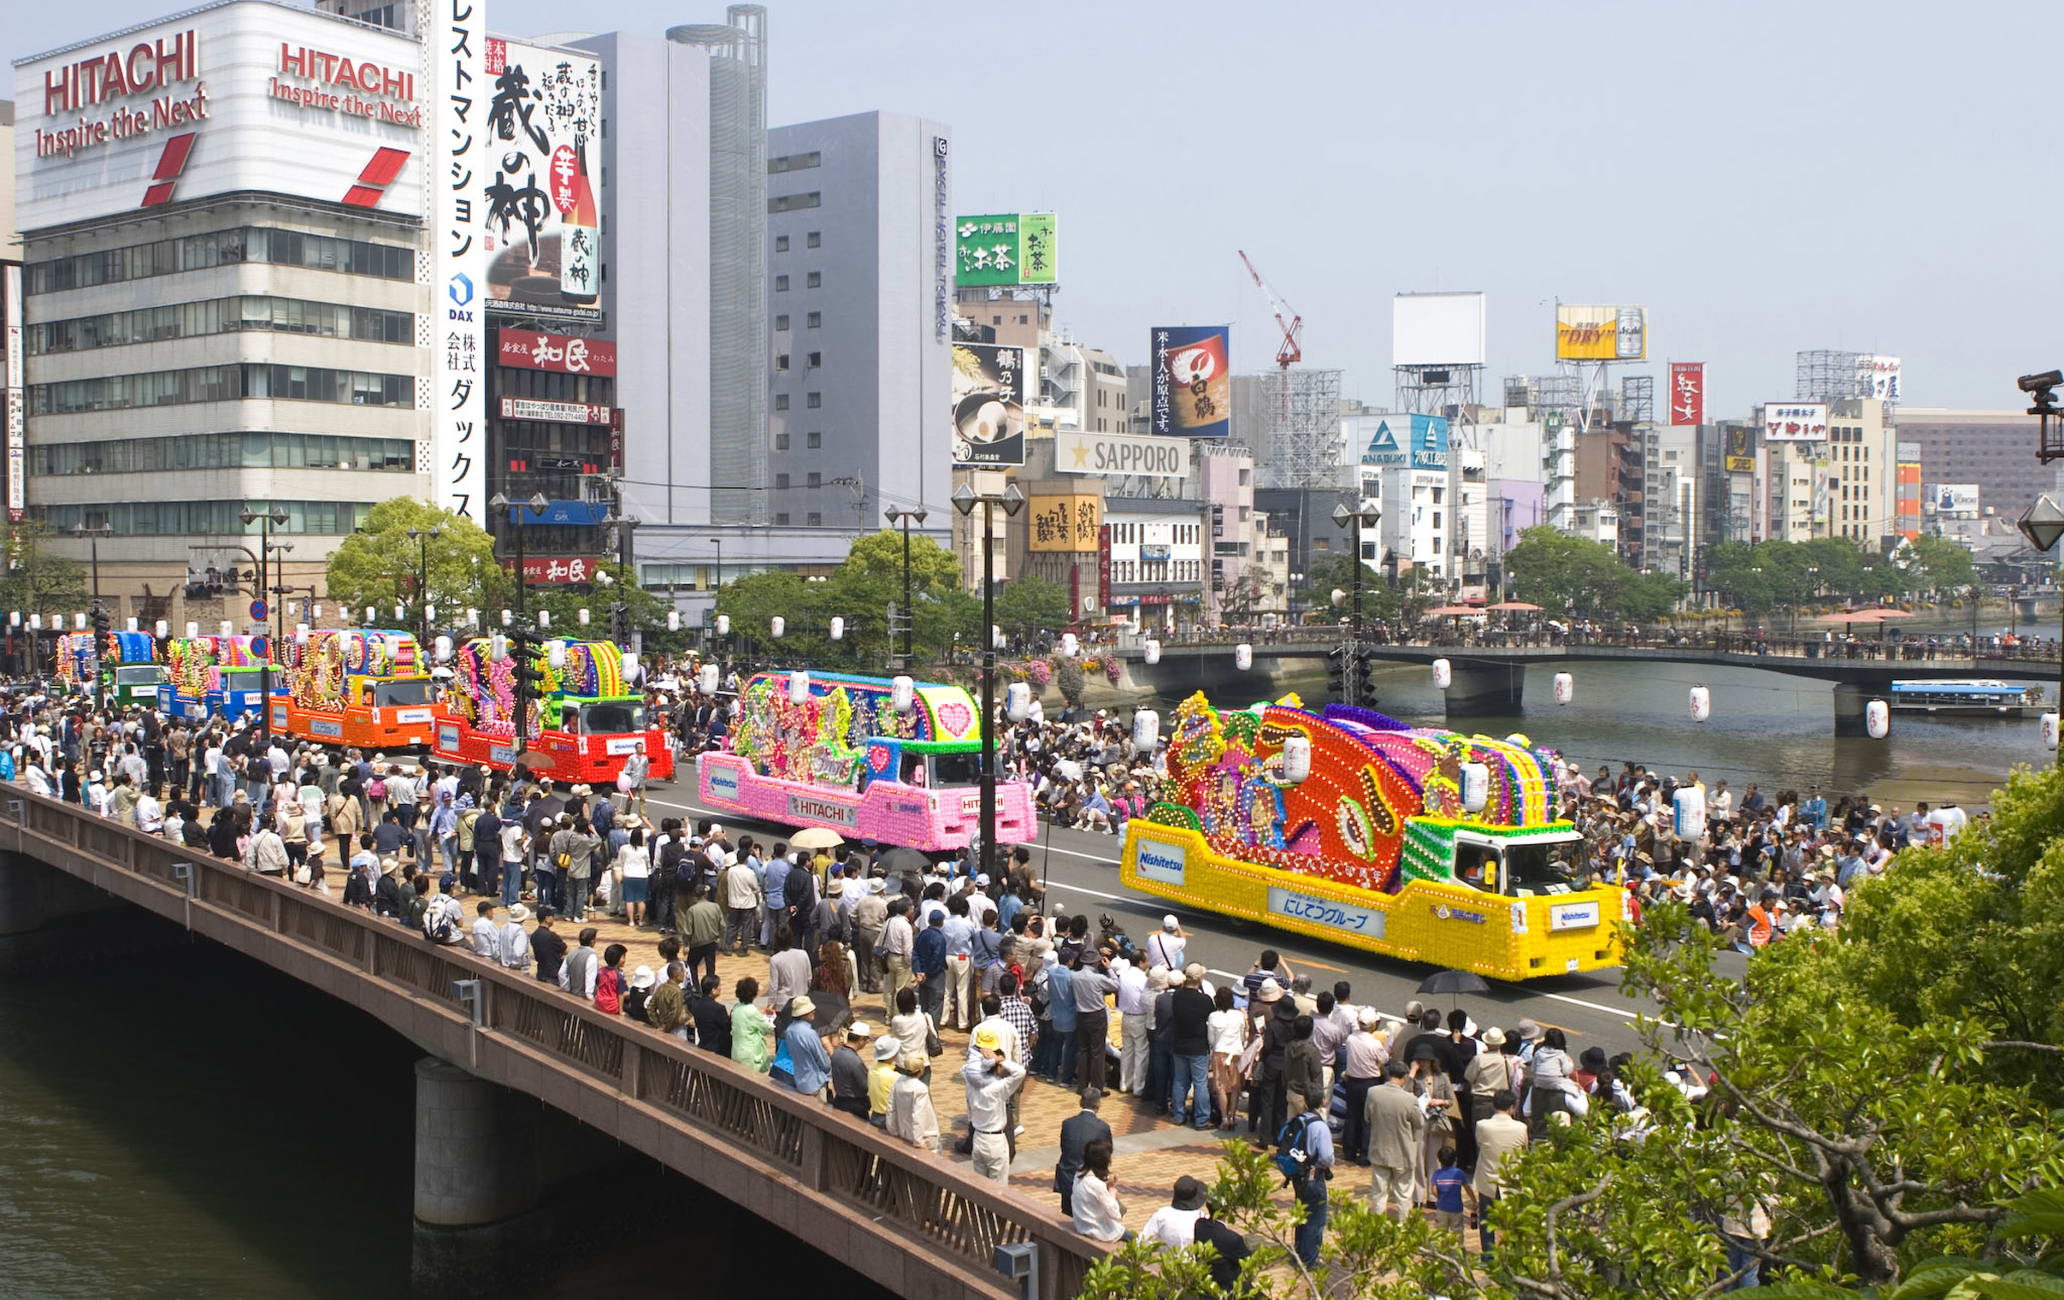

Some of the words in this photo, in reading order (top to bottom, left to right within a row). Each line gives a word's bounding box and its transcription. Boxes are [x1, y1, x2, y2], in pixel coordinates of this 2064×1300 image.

[44, 30, 199, 116] HITACHI
[281, 43, 413, 102] HITACHI
[493, 41, 504, 75] 本格
[36, 115, 108, 159] Inspire
[111, 103, 148, 138] the
[153, 80, 208, 131] Next
[270, 77, 339, 110] Inspire
[342, 90, 374, 116] the
[379, 97, 421, 127] Next
[485, 64, 551, 269] 蔵の神
[569, 227, 590, 291] 蔵の神
[449, 309, 474, 322] DAX
[1619, 326, 1641, 335] Asahi
[532, 335, 591, 372] 和民
[996, 349, 1016, 402] 鶴乃子
[1190, 373, 1216, 419] 白鶴
[450, 379, 474, 519] ダックス
[1094, 441, 1179, 472] SAPPORO
[1362, 454, 1407, 464] ANABUKI
[546, 558, 586, 582] 和民
[800, 800, 844, 820] HITACHI
[1140, 850, 1183, 872] Nishitetsu
[1284, 898, 1369, 929] にしてつグループ
